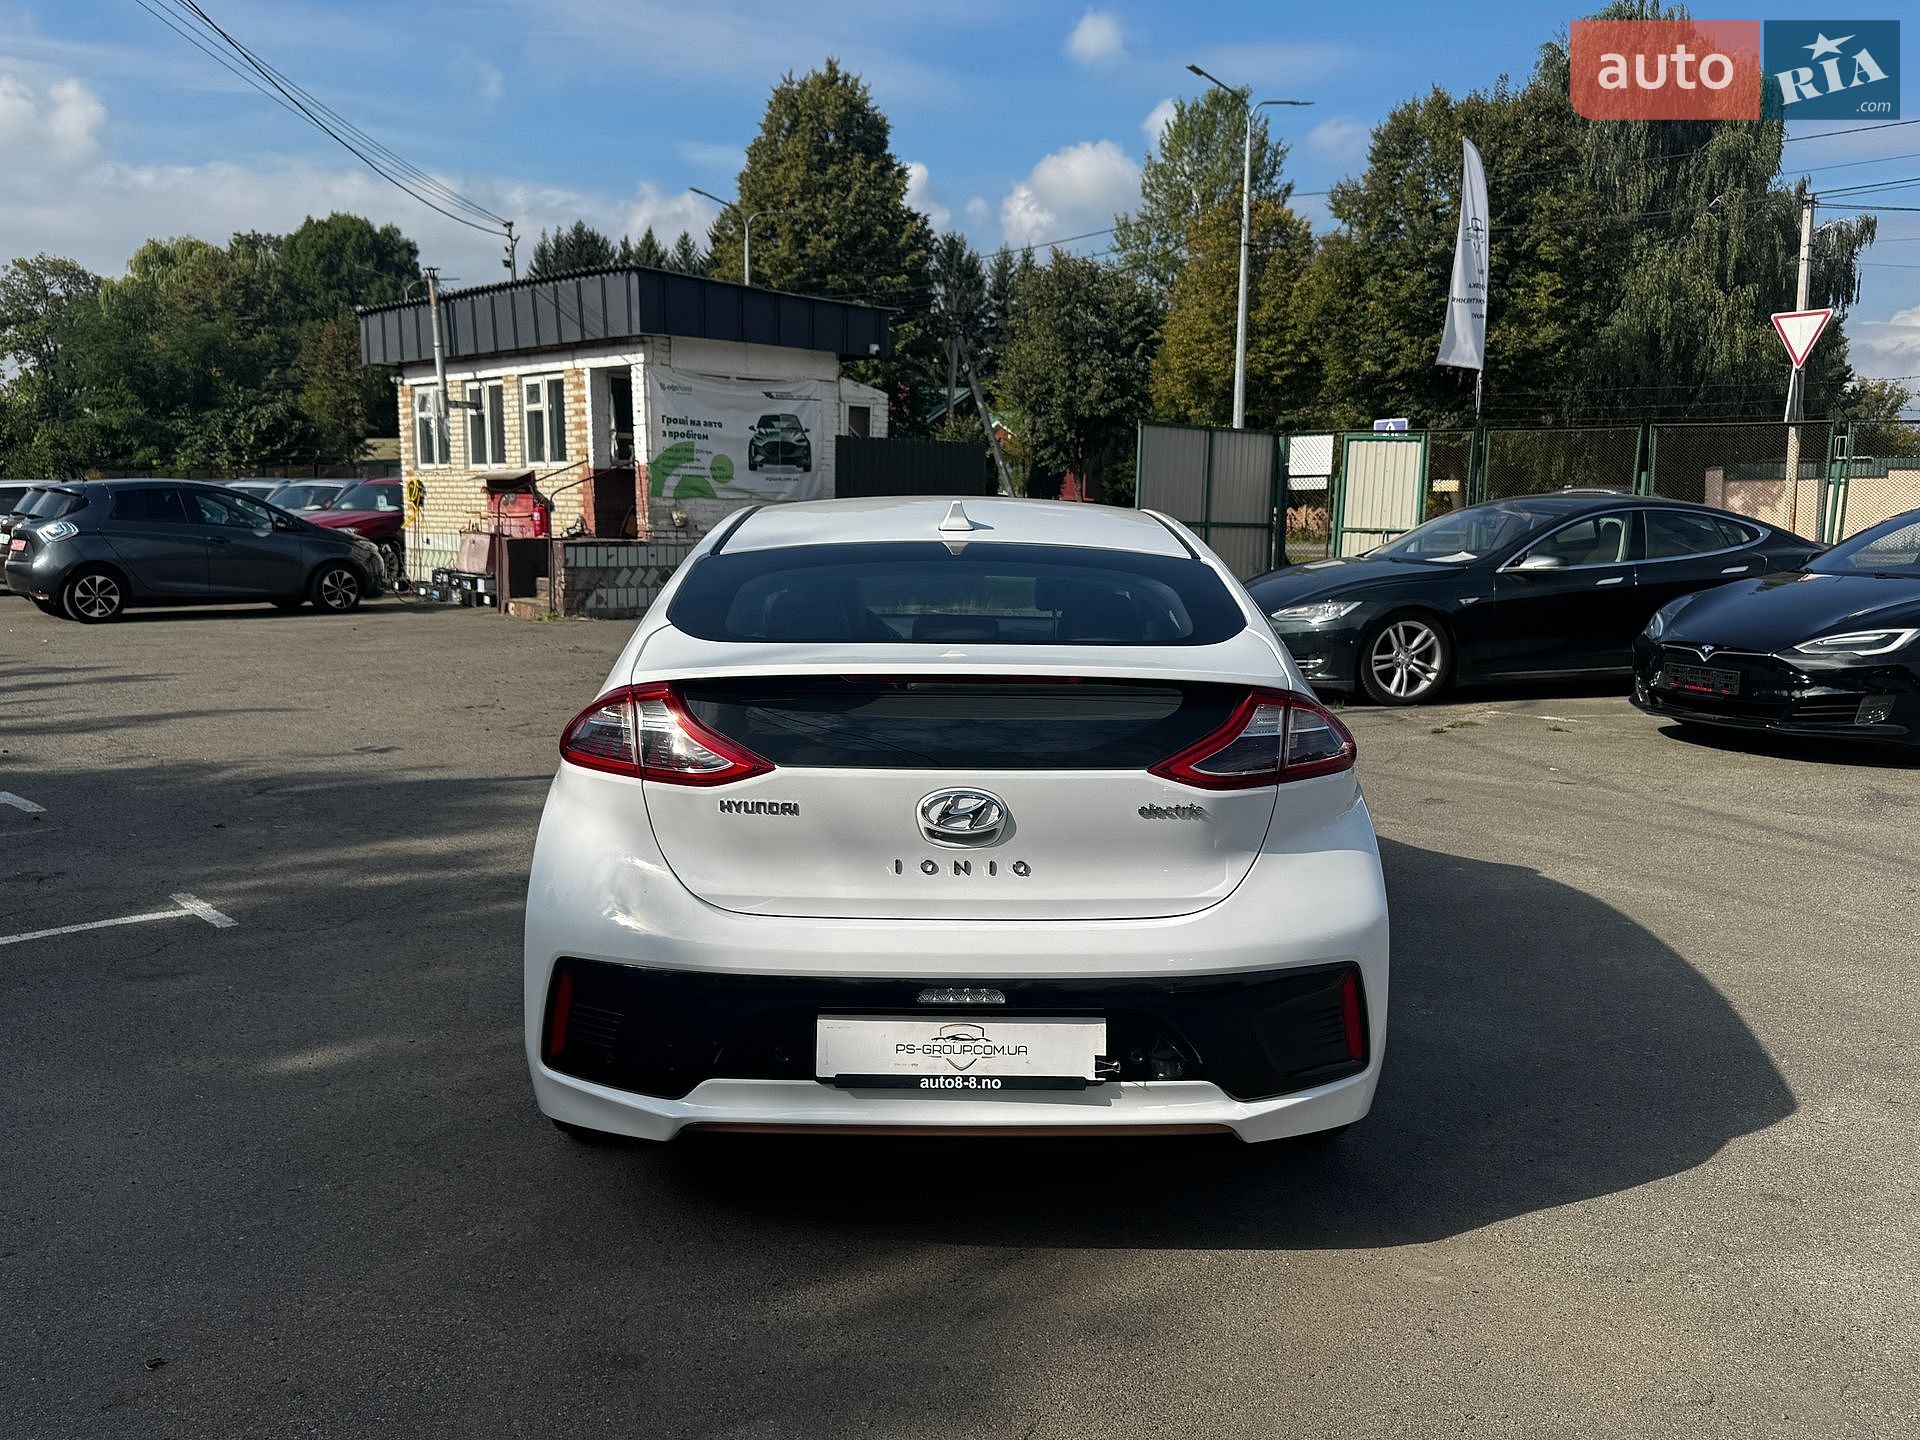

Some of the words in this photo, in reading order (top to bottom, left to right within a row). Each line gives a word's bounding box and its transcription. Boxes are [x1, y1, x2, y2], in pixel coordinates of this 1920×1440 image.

[661, 415, 688, 426] Гроші
[690, 418, 702, 427] на
[703, 420, 723, 429] авто
[668, 430, 709, 441] пробігом
[719, 799, 800, 817] HYUNDAI
[1137, 802, 1206, 820] electric
[894, 858, 1032, 877] IONIQ
[919, 1075, 1002, 1090] auto8-8.no
